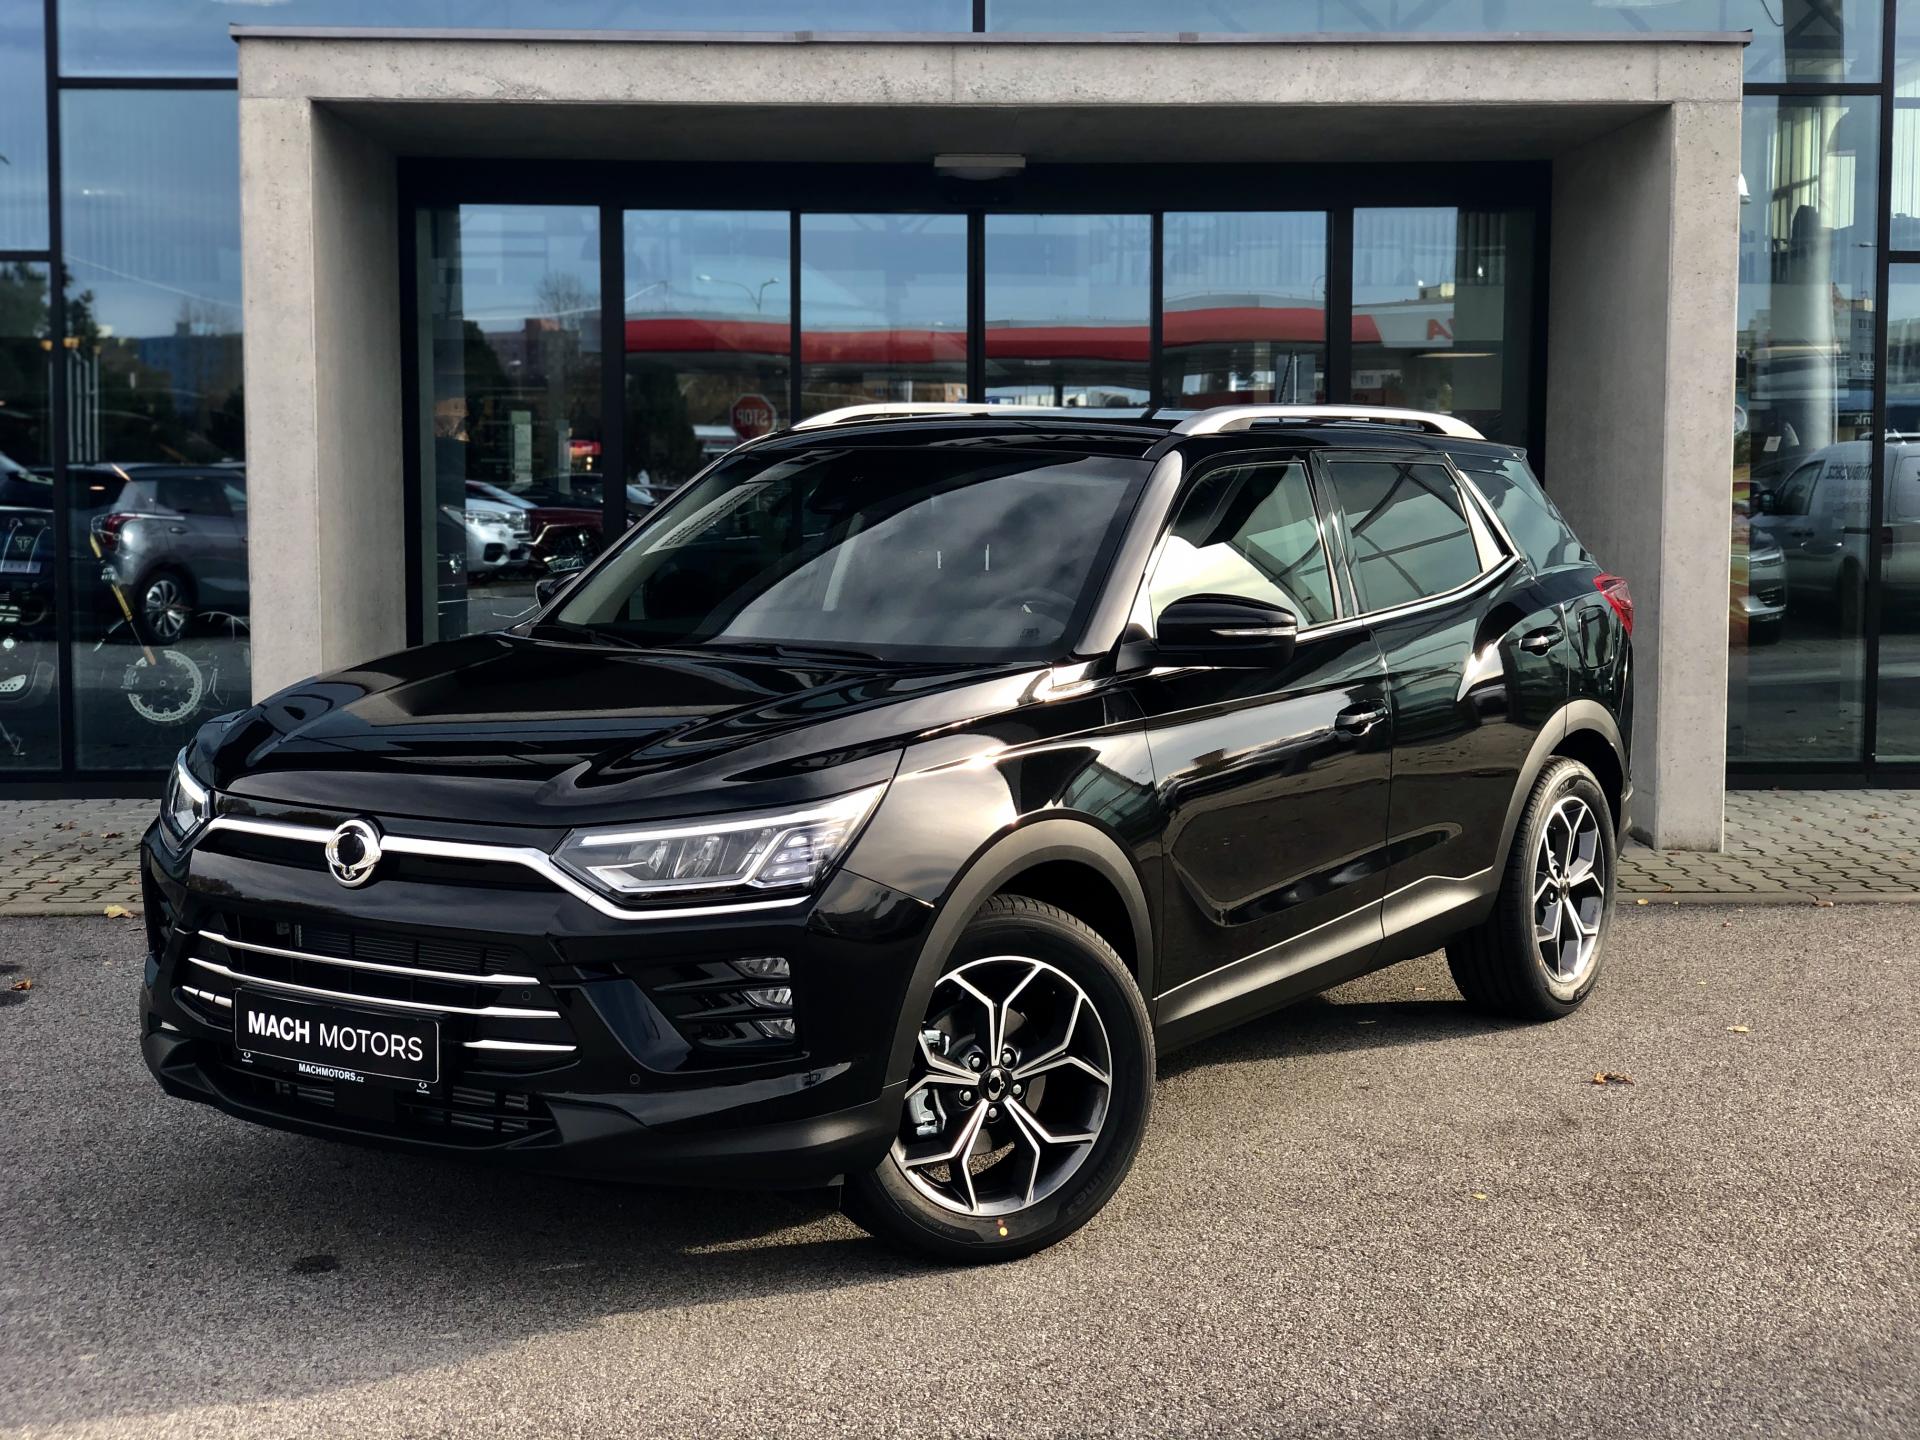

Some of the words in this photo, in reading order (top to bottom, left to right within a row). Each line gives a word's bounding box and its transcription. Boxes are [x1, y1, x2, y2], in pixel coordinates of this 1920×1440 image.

[248, 1010, 310, 1044] MACH
[319, 1023, 423, 1062] MOTORS
[298, 1063, 365, 1083] MACHMOTORS.cz
